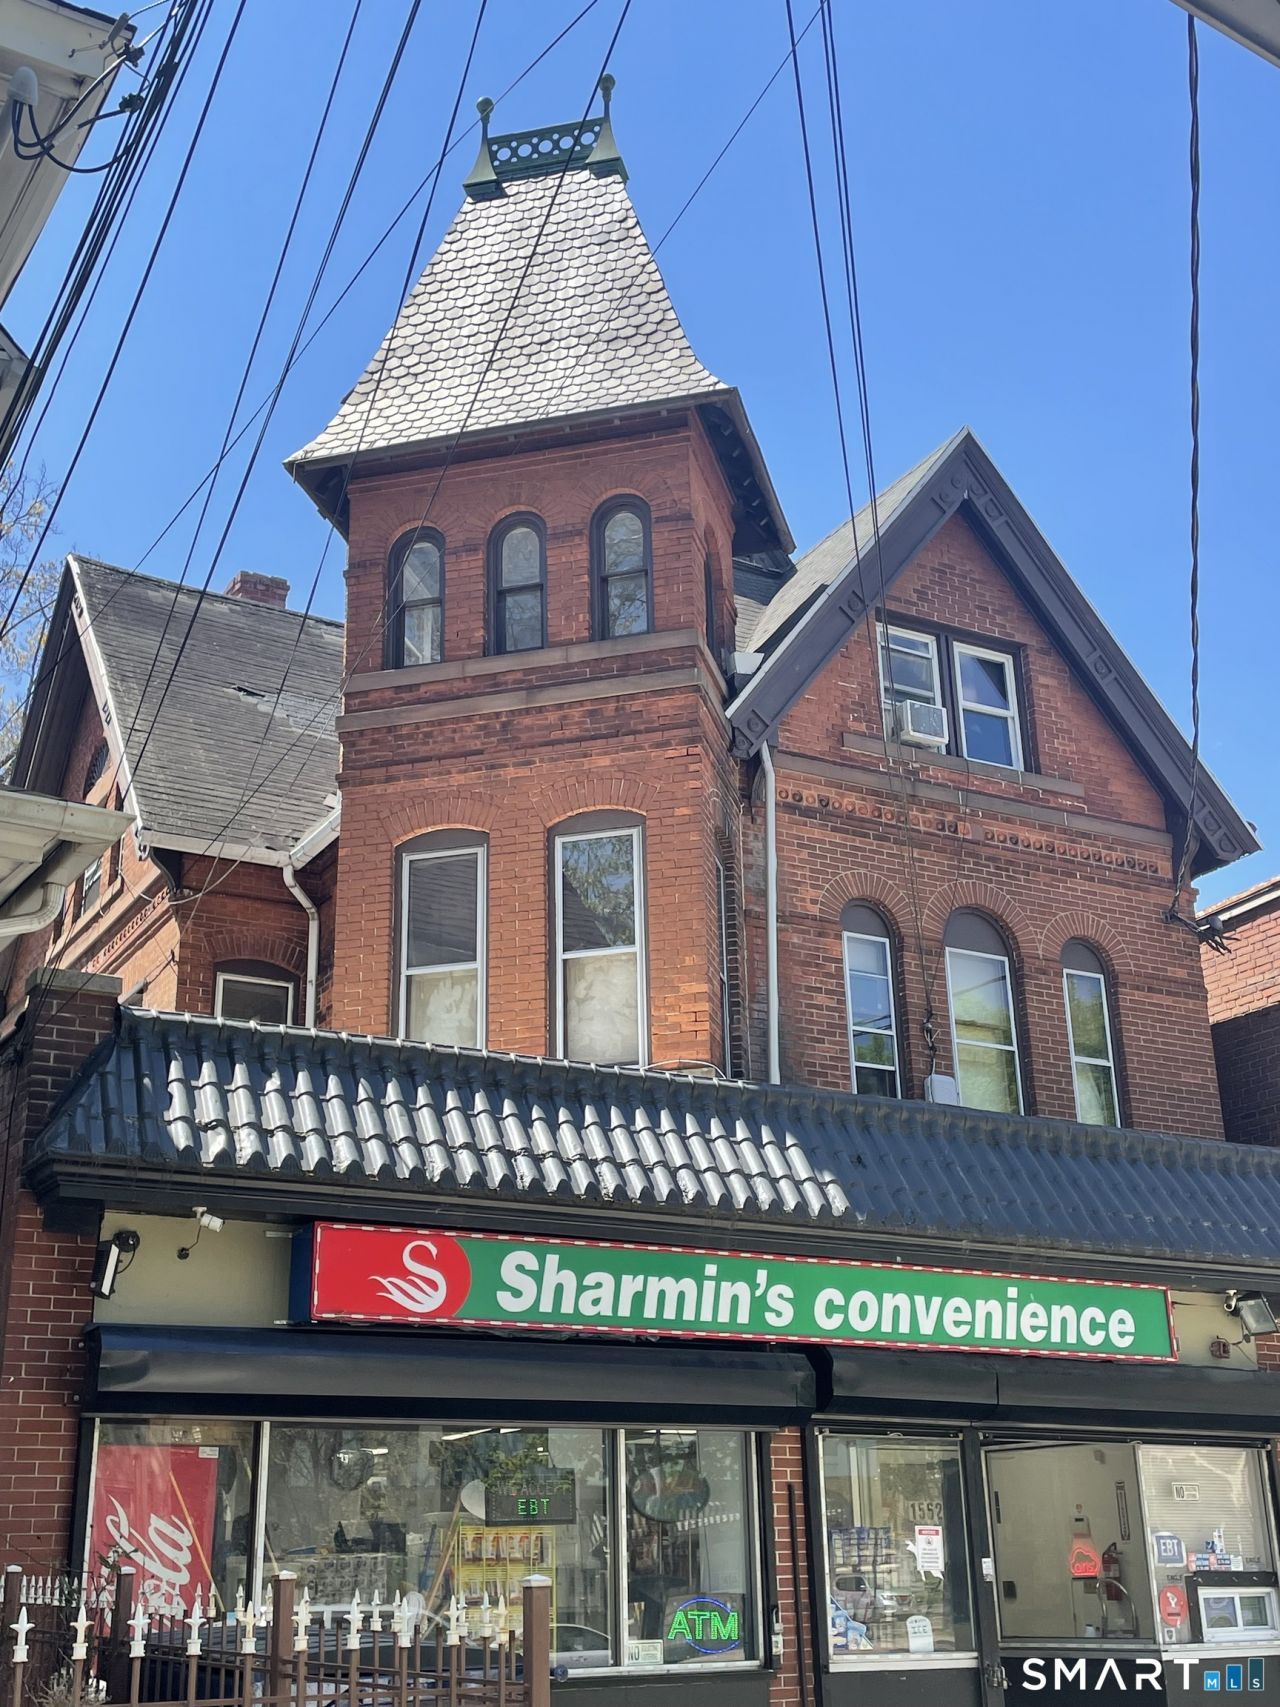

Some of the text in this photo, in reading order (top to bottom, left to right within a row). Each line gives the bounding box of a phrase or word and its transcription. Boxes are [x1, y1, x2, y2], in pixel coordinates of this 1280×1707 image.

[496, 1250, 1136, 1348] Sharmin's convenience
[517, 1498, 550, 1515] EBT
[1160, 1539, 1179, 1556] EBT
[667, 1610, 739, 1640] ATM
